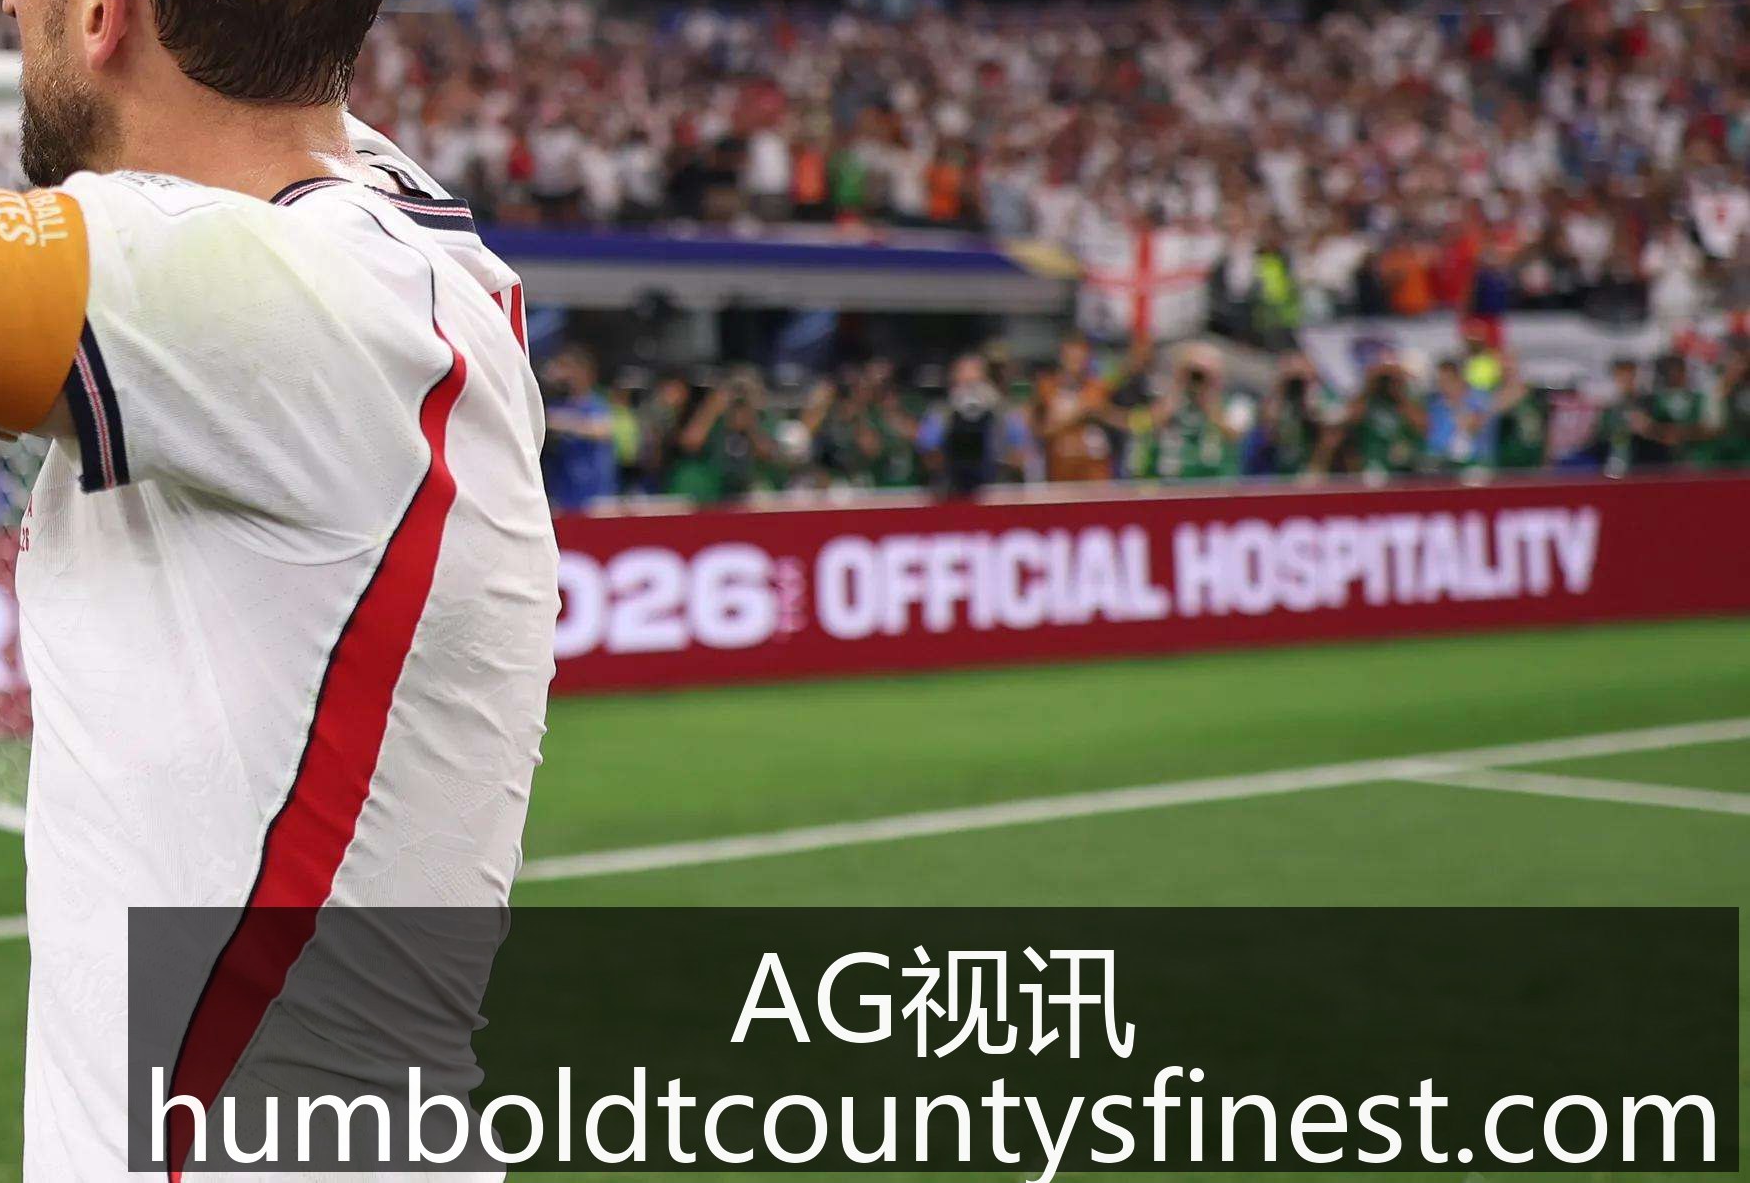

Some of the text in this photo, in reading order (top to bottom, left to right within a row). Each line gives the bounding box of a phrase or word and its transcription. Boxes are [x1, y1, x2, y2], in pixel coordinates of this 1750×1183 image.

[552, 540, 779, 661] 026
[814, 524, 1171, 640] OFFICIAL
[1173, 506, 1601, 618] HOSPITALITY
